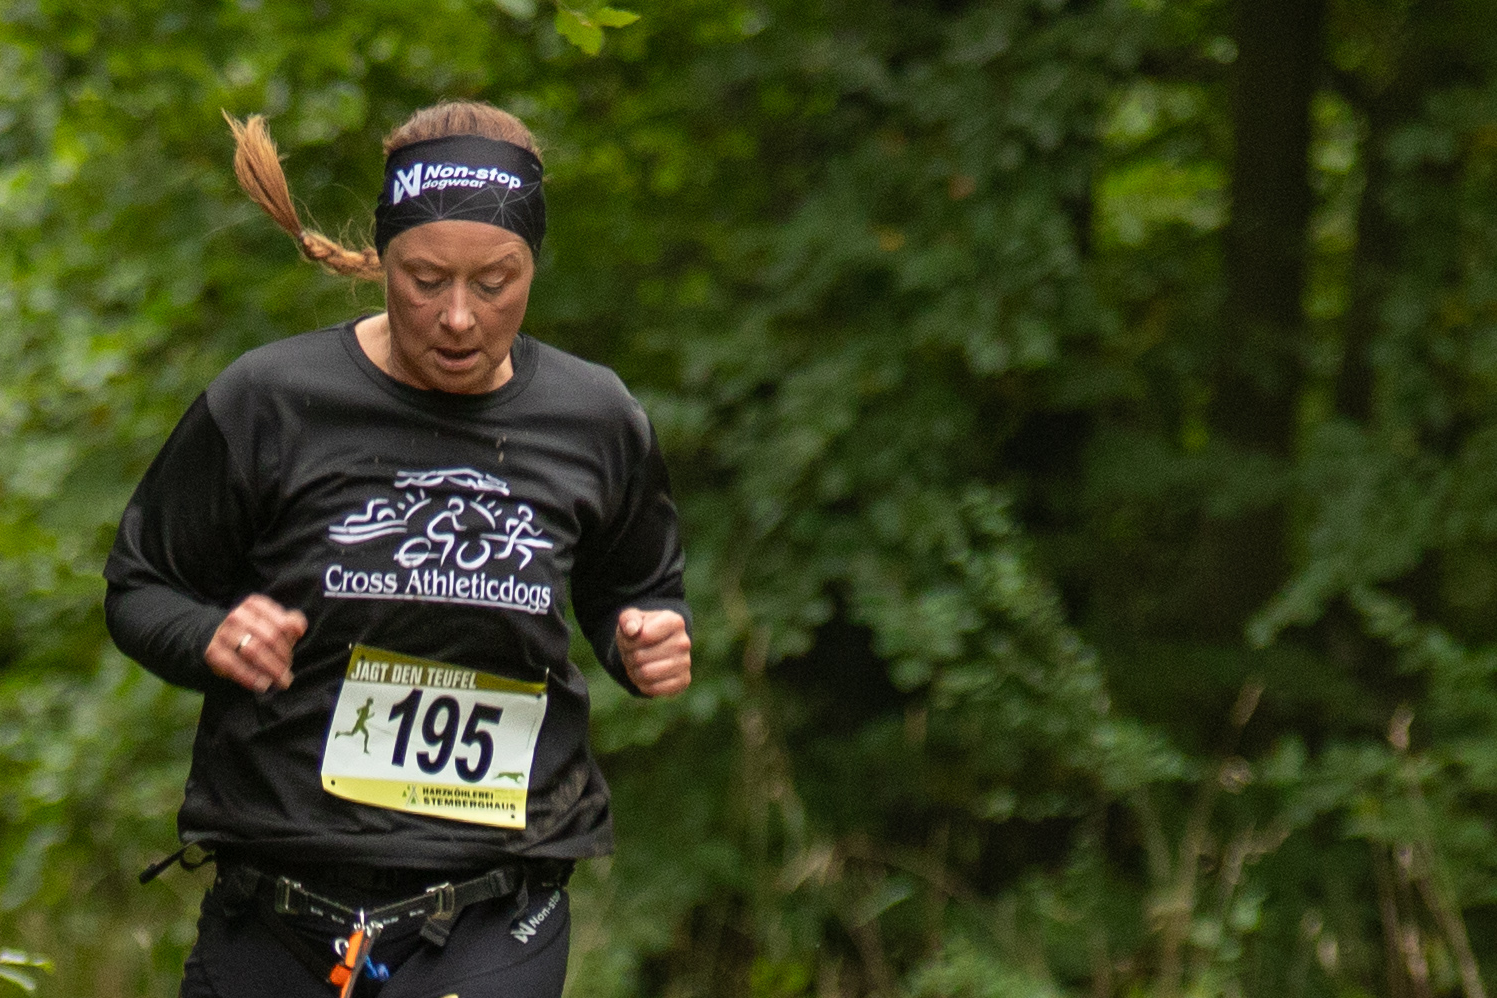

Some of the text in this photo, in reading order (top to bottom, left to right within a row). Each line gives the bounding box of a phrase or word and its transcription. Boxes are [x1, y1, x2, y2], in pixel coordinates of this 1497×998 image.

[422, 178, 486, 190] dogwear
[425, 164, 522, 189] Non-stop
[325, 564, 551, 612] Cross Athleticdogs
[351, 660, 477, 690] JAGT DEN TEUFEL
[388, 688, 504, 783] 195
[422, 786, 494, 800] HARZKÖHLEREI
[423, 796, 516, 811] STEMBERGHAUS
